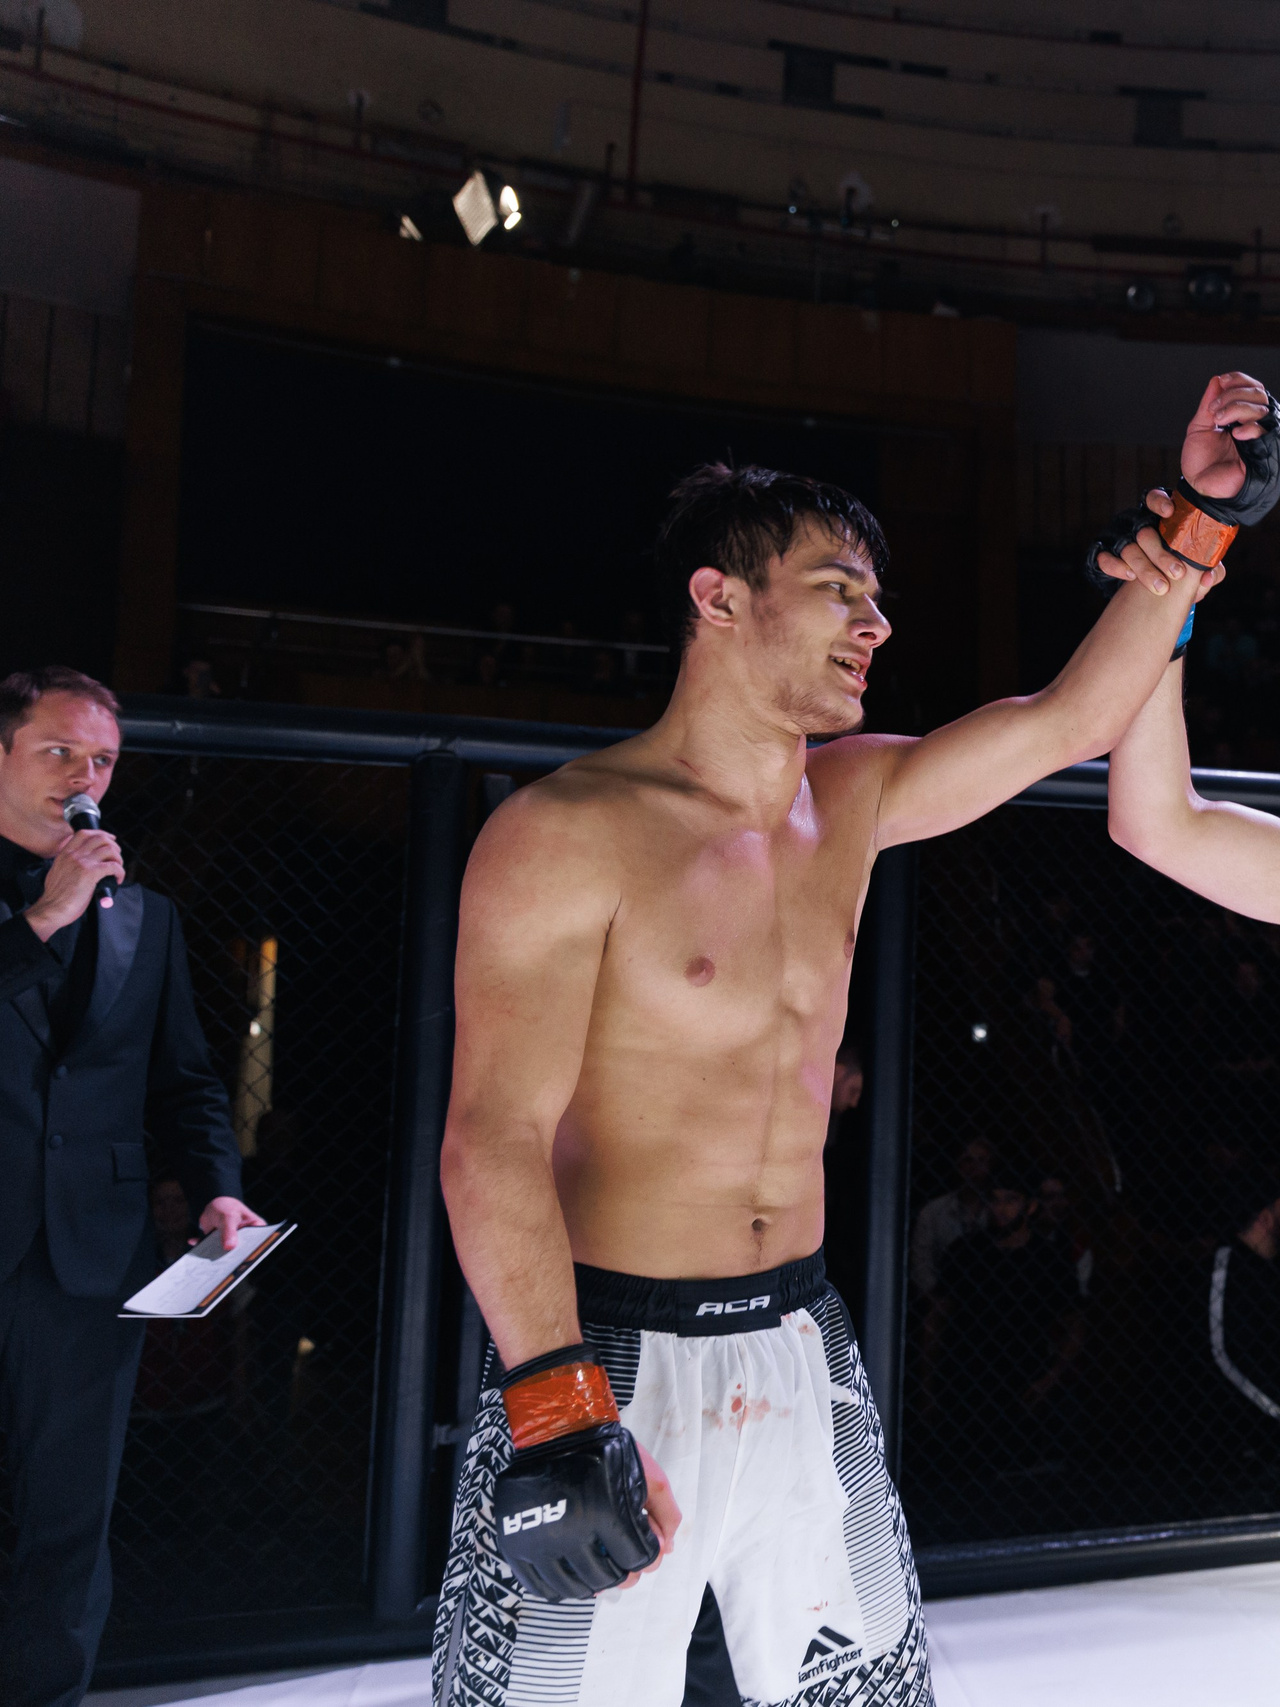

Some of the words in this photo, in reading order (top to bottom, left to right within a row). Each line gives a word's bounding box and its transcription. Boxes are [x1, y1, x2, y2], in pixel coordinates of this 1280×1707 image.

[695, 1294, 771, 1317] ACA
[503, 1498, 567, 1536] ACA
[798, 1647, 863, 1684] iamfighter
